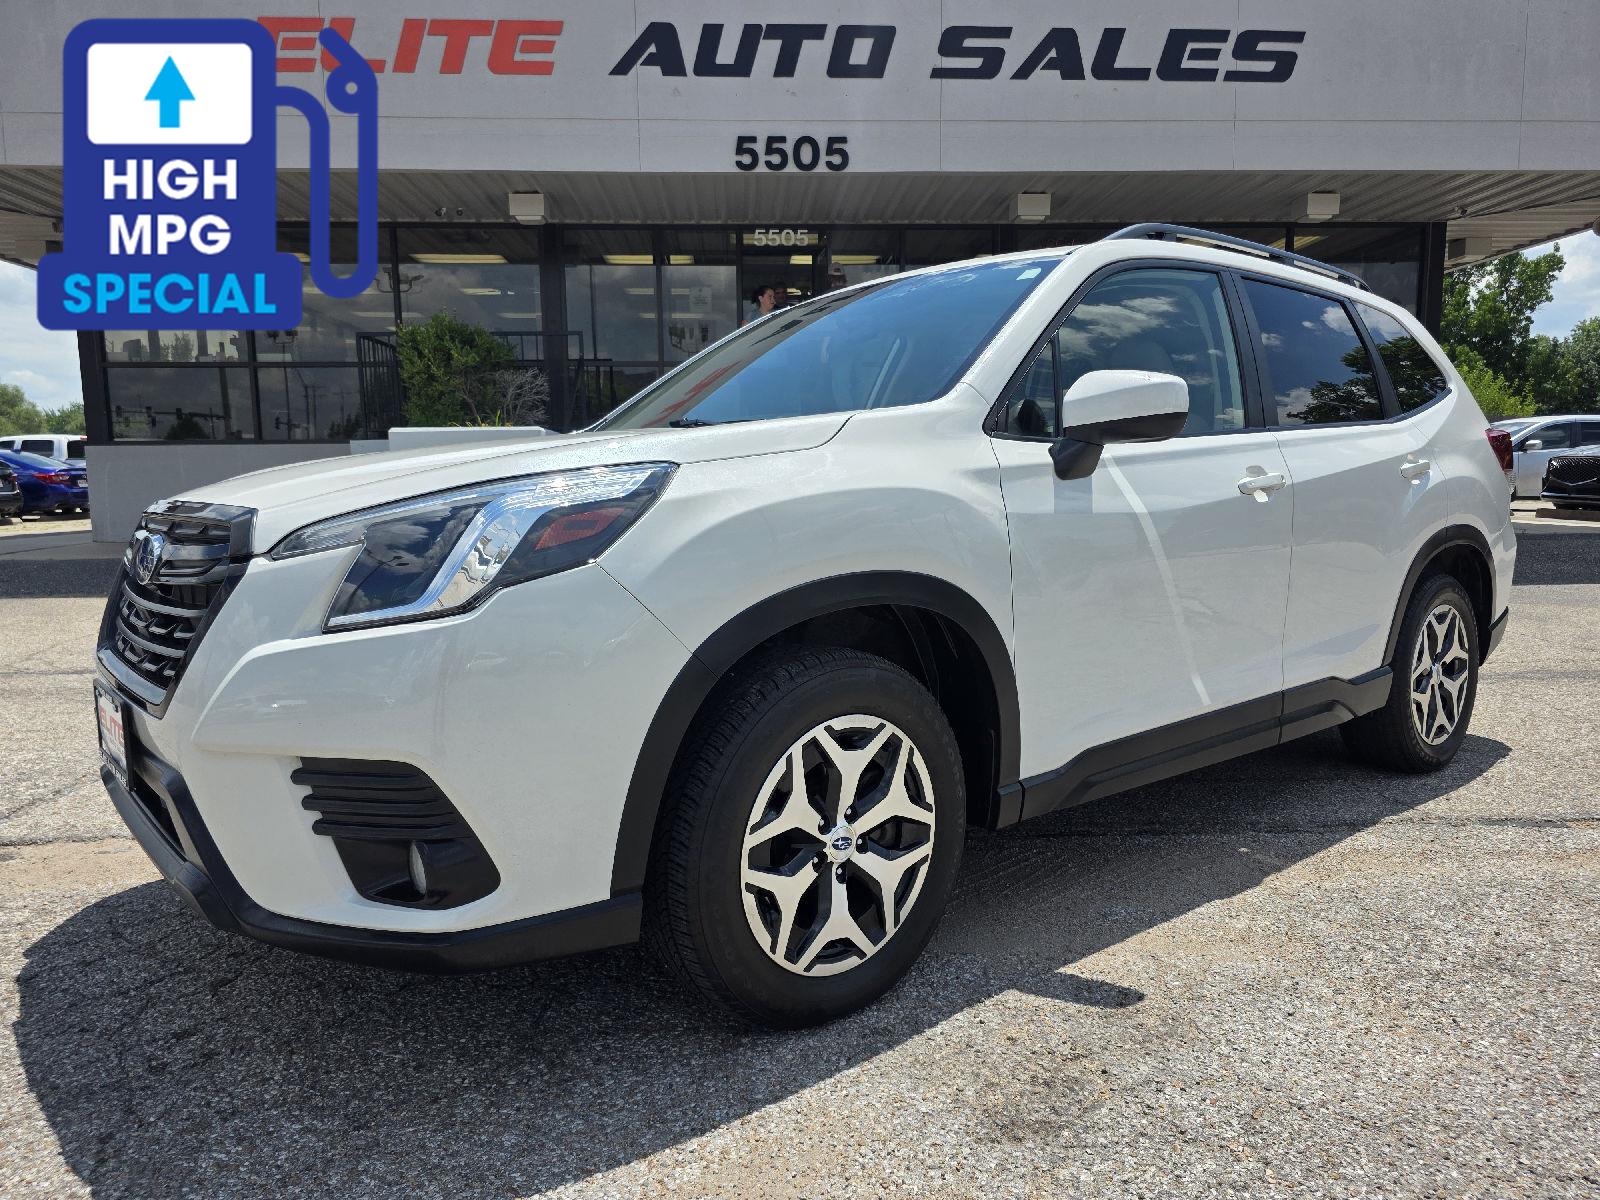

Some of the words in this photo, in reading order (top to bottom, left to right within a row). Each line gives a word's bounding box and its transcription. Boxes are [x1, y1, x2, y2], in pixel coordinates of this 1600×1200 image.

[608, 21, 897, 78] AUTO
[930, 25, 1307, 83] SALES
[734, 135, 850, 172] 5505
[753, 229, 809, 247] 5505
